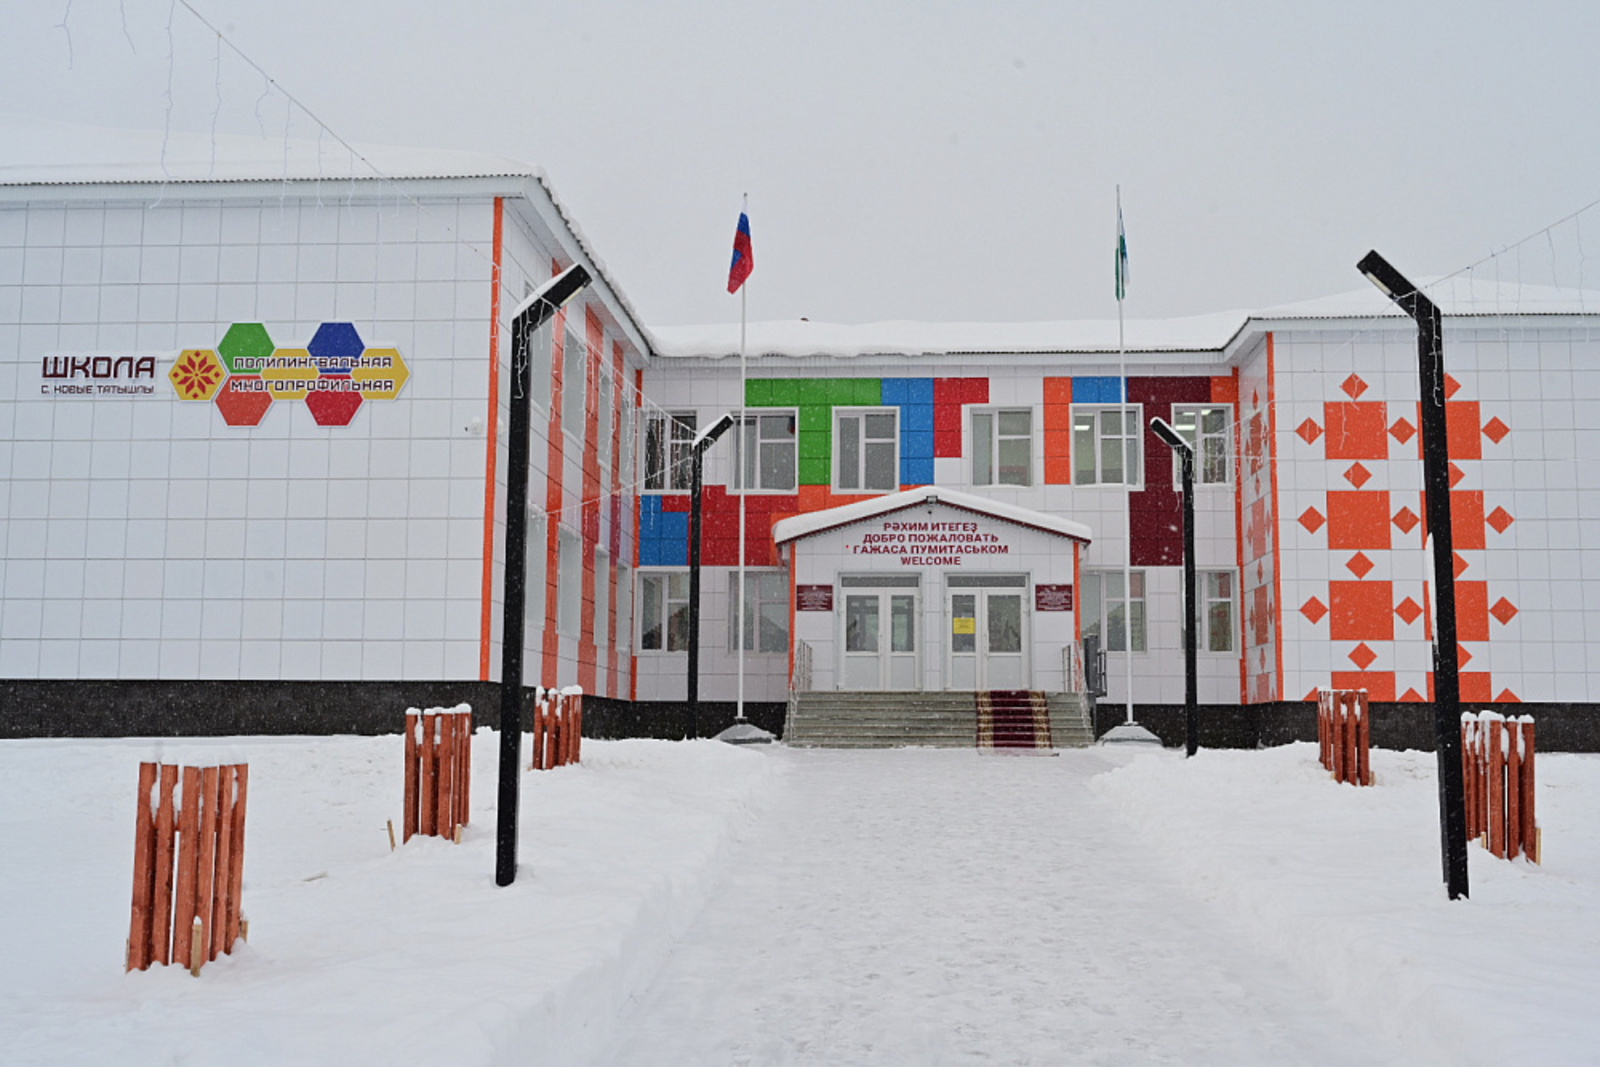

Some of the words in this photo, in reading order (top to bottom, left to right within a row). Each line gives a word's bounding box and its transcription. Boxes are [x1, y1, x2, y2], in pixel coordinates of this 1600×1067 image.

[42, 356, 156, 379] ШКОЛА
[234, 357, 393, 369] ПОЛИЛИНГВАЛЬНАЯ
[54, 385, 94, 394] НОВЫЕ
[97, 385, 155, 394] ТАТЫШЛЫ
[230, 379, 394, 392] МНОГОПРОФИЛЬНАЯ
[883, 522, 929, 532] РӘХИМ
[863, 534, 906, 544] ДОБРО
[908, 533, 999, 543] ПОЖАЛОВАТЬ
[853, 545, 908, 554] ГАЖАСА
[910, 545, 1009, 554] ПУМИТАСЬКОМ
[900, 556, 961, 566] WELCOME
